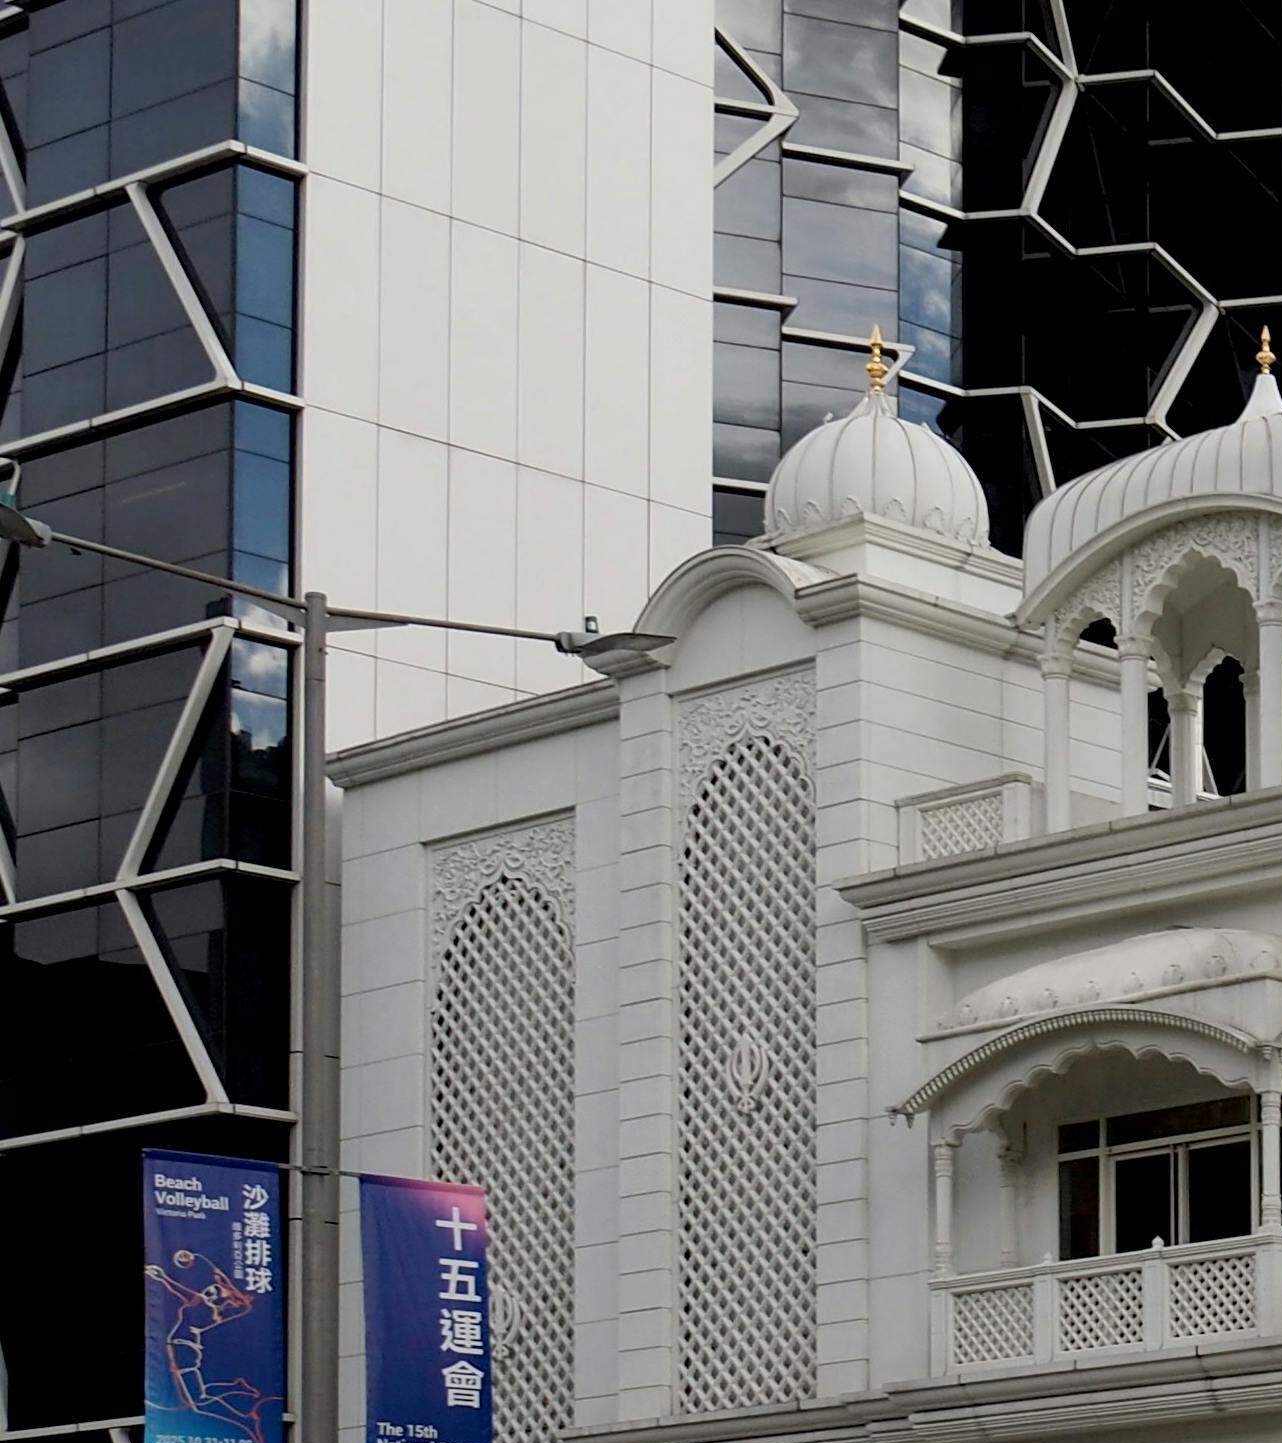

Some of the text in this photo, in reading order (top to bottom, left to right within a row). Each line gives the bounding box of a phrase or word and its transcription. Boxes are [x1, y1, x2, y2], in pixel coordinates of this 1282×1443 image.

[154, 1174, 202, 1191] Beach
[154, 1191, 230, 1211] Volleyball
[242, 1183, 273, 1294] 沙灘排球
[435, 1206, 485, 1409] 十五運會
[376, 1422, 438, 1439] The 15th
